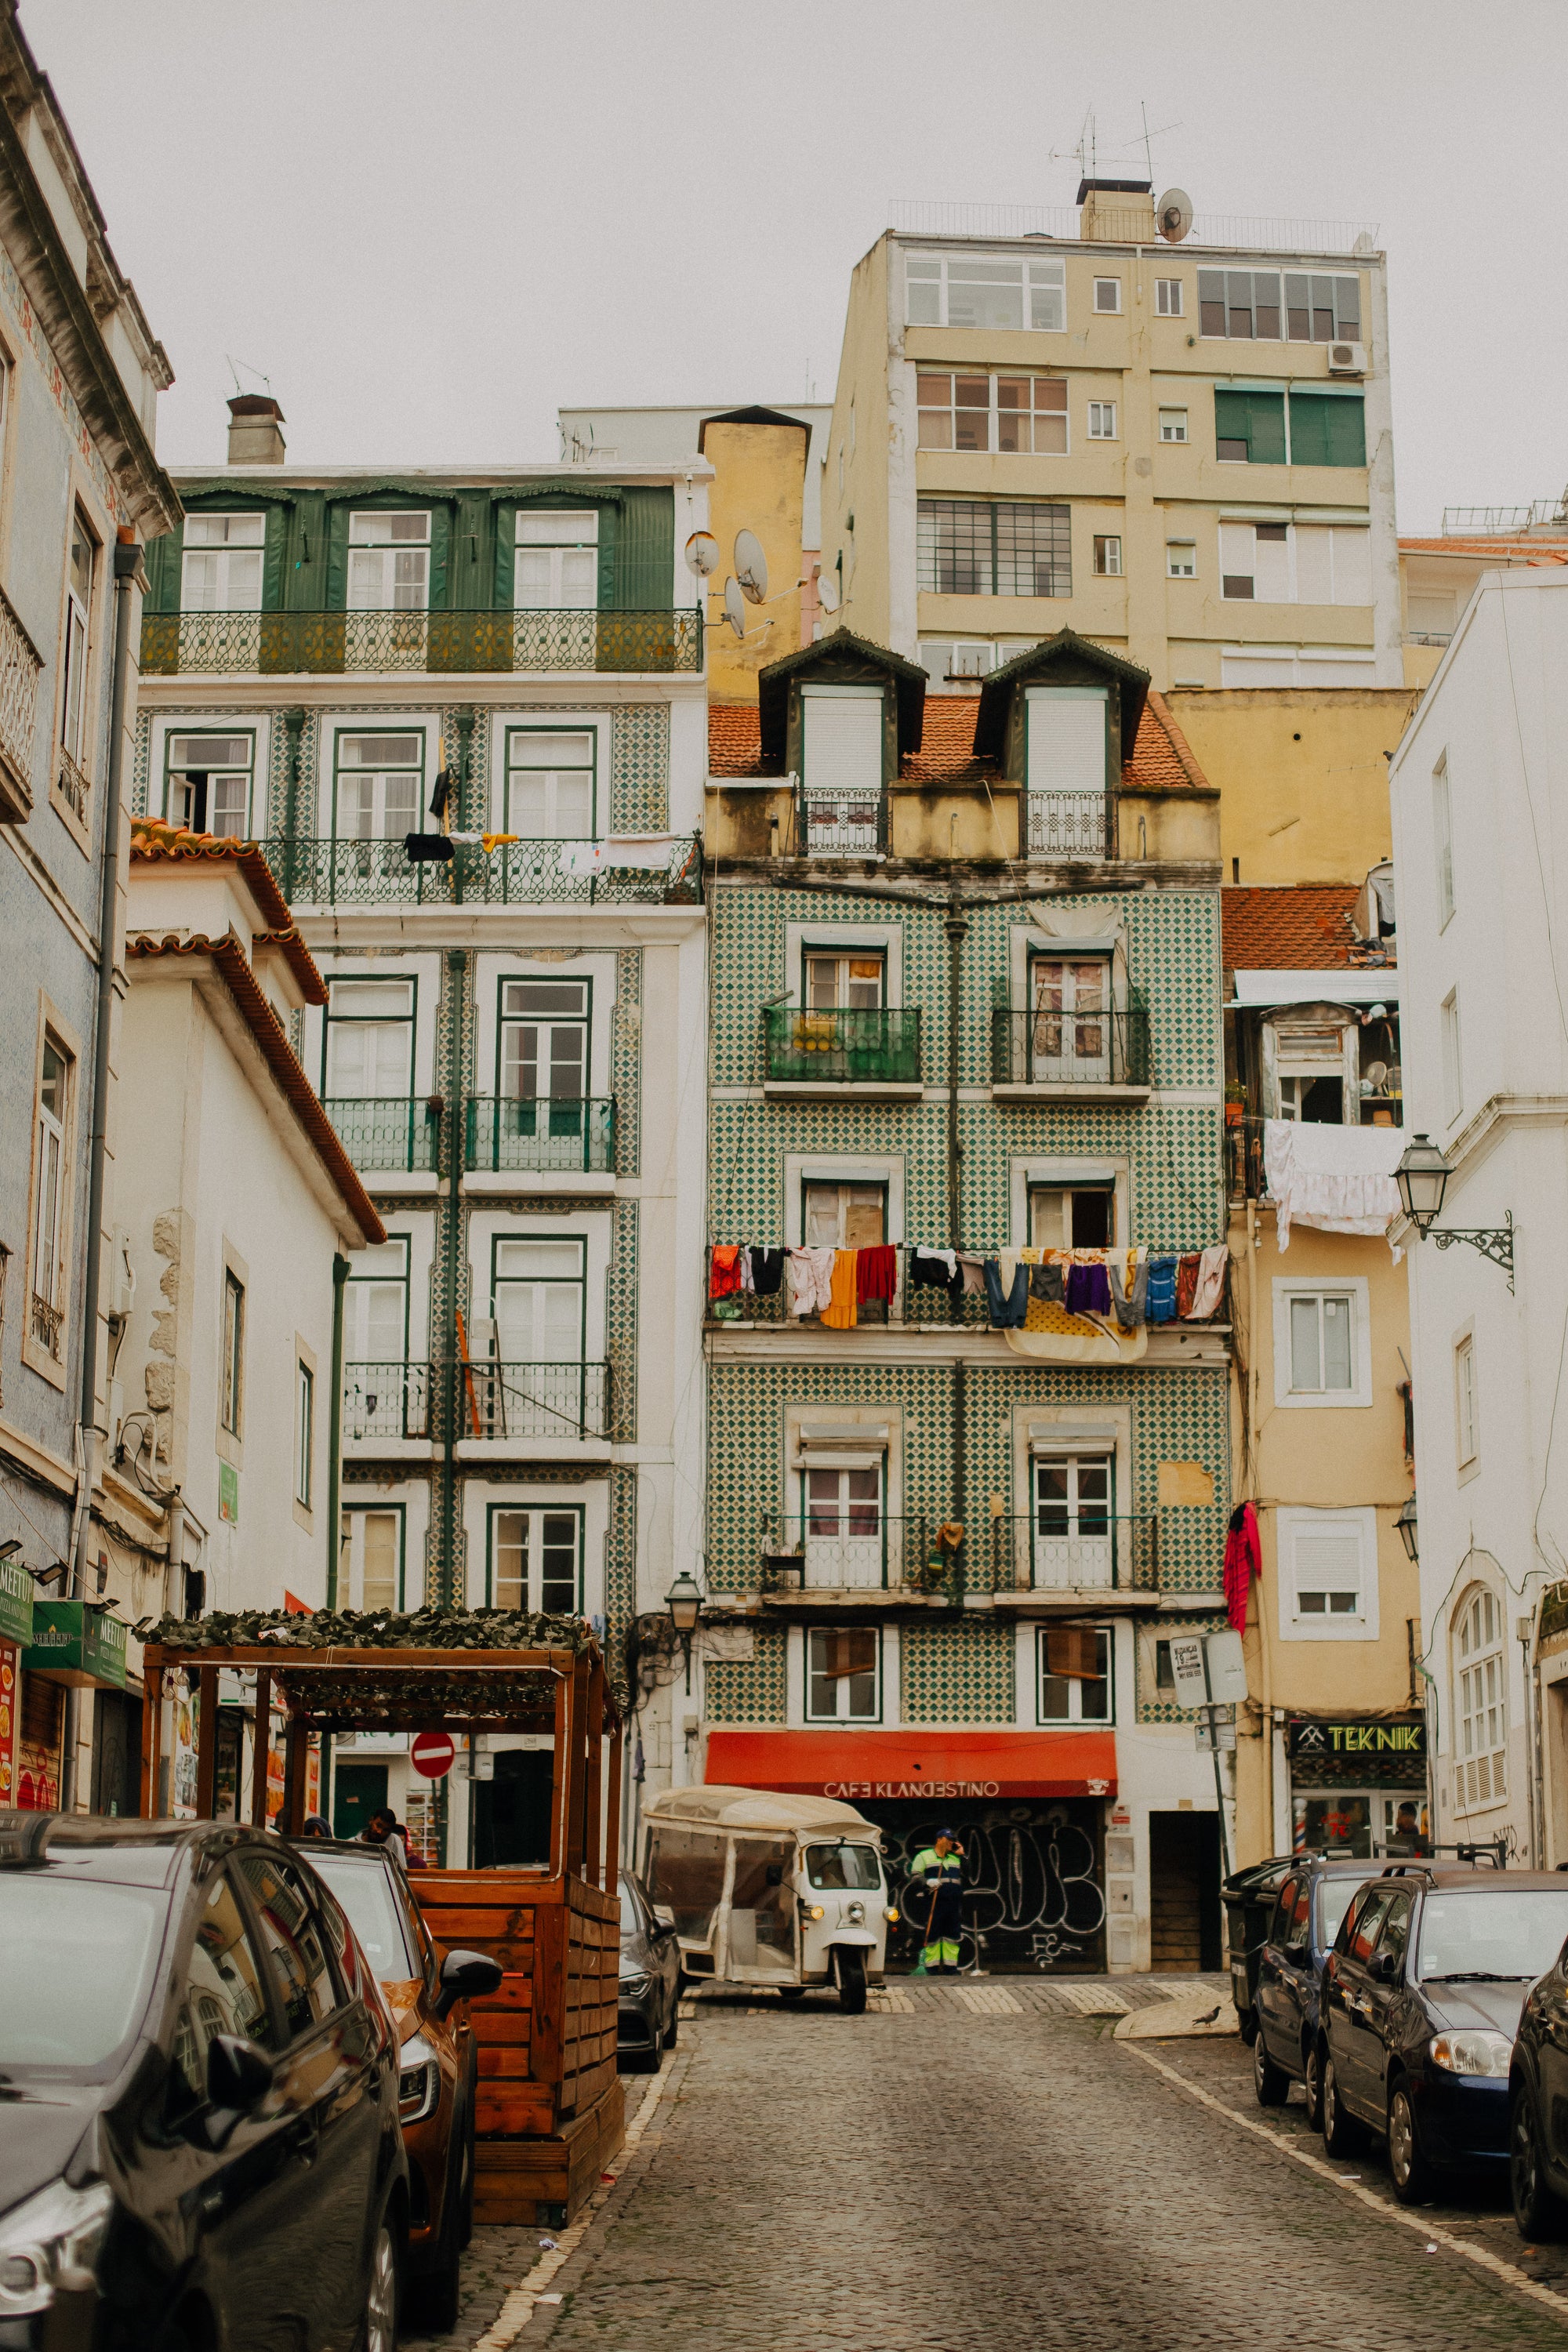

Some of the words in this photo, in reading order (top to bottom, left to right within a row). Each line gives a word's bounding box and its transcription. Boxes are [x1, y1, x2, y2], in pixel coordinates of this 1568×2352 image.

[0, 1563, 33, 1604] MEETUP
[100, 1617, 126, 1651] MEETUP
[1327, 1726, 1422, 1751] TEKNIK
[876, 1781, 1000, 1798] KLANDESTINO
